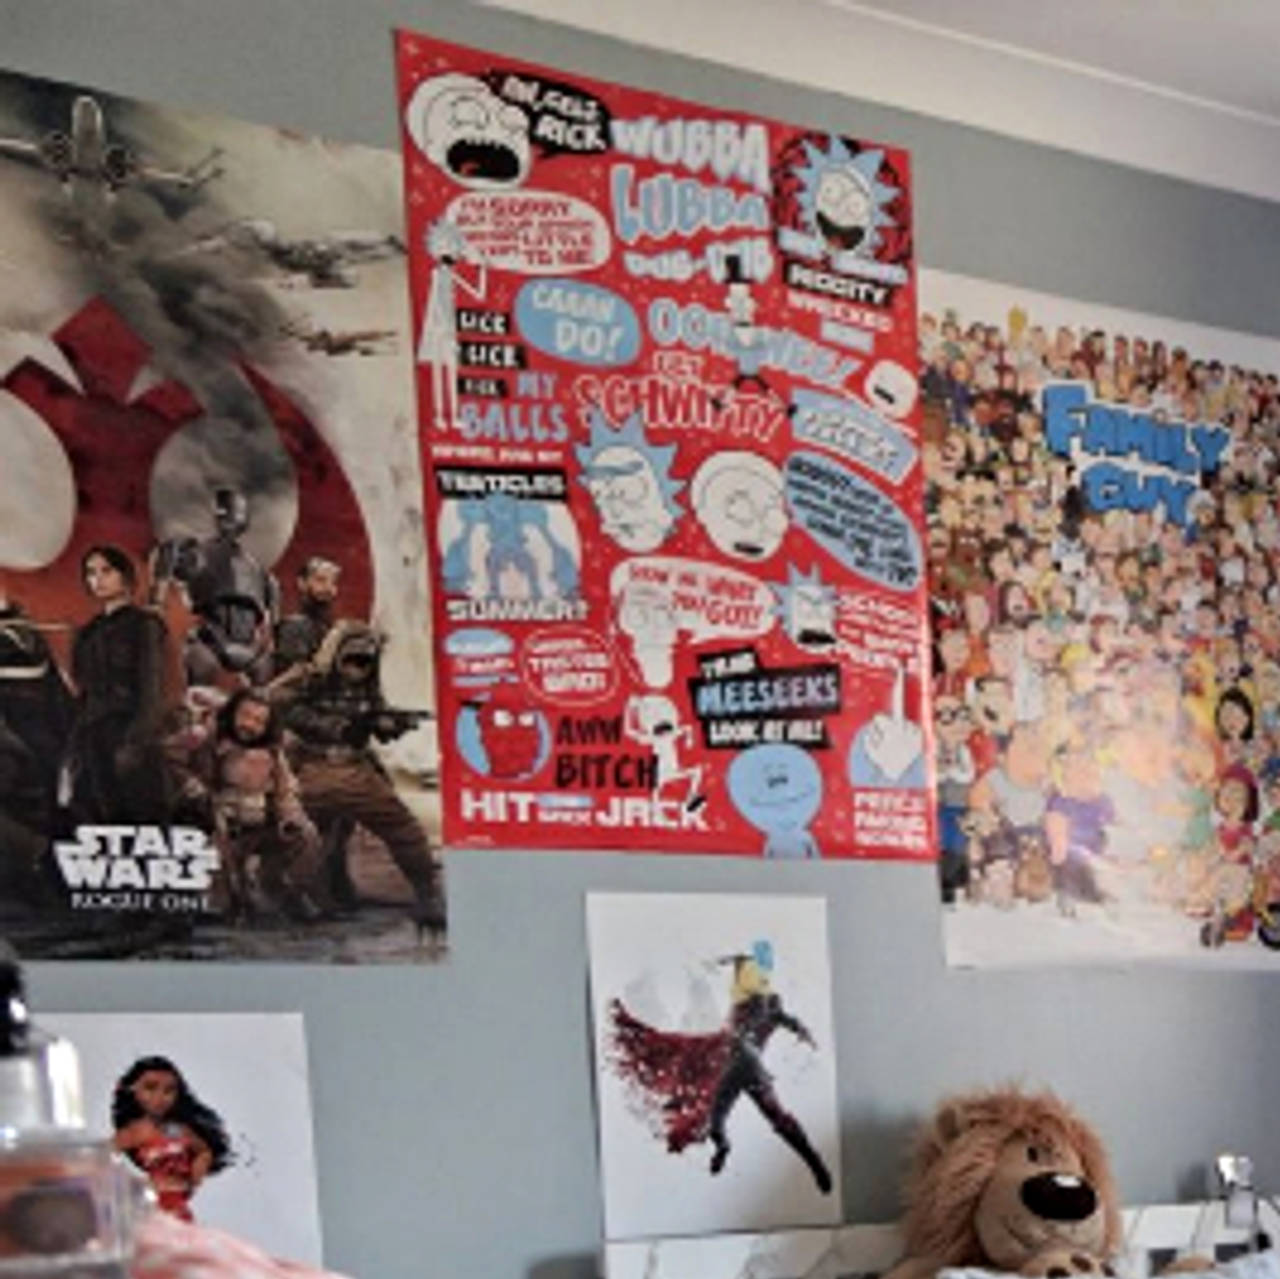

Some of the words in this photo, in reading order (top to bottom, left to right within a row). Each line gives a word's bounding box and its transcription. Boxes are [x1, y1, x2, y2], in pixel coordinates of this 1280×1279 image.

[610, 116, 772, 198] WUBBA
[611, 162, 770, 245] LUBBA
[555, 318, 625, 361] DO!
[460, 401, 568, 443] BALLS
[1042, 382, 1230, 473] FAMILY
[1079, 462, 1197, 527] GUY
[696, 672, 837, 717] MEESEEKS
[556, 715, 623, 745] AWW
[555, 754, 659, 789] BITCH
[460, 790, 535, 823] HIT
[595, 795, 708, 831] JACK
[54, 824, 216, 857] STAR
[56, 853, 221, 890] WARS
[71, 893, 152, 911] ROGUE
[163, 894, 209, 912] ONE
